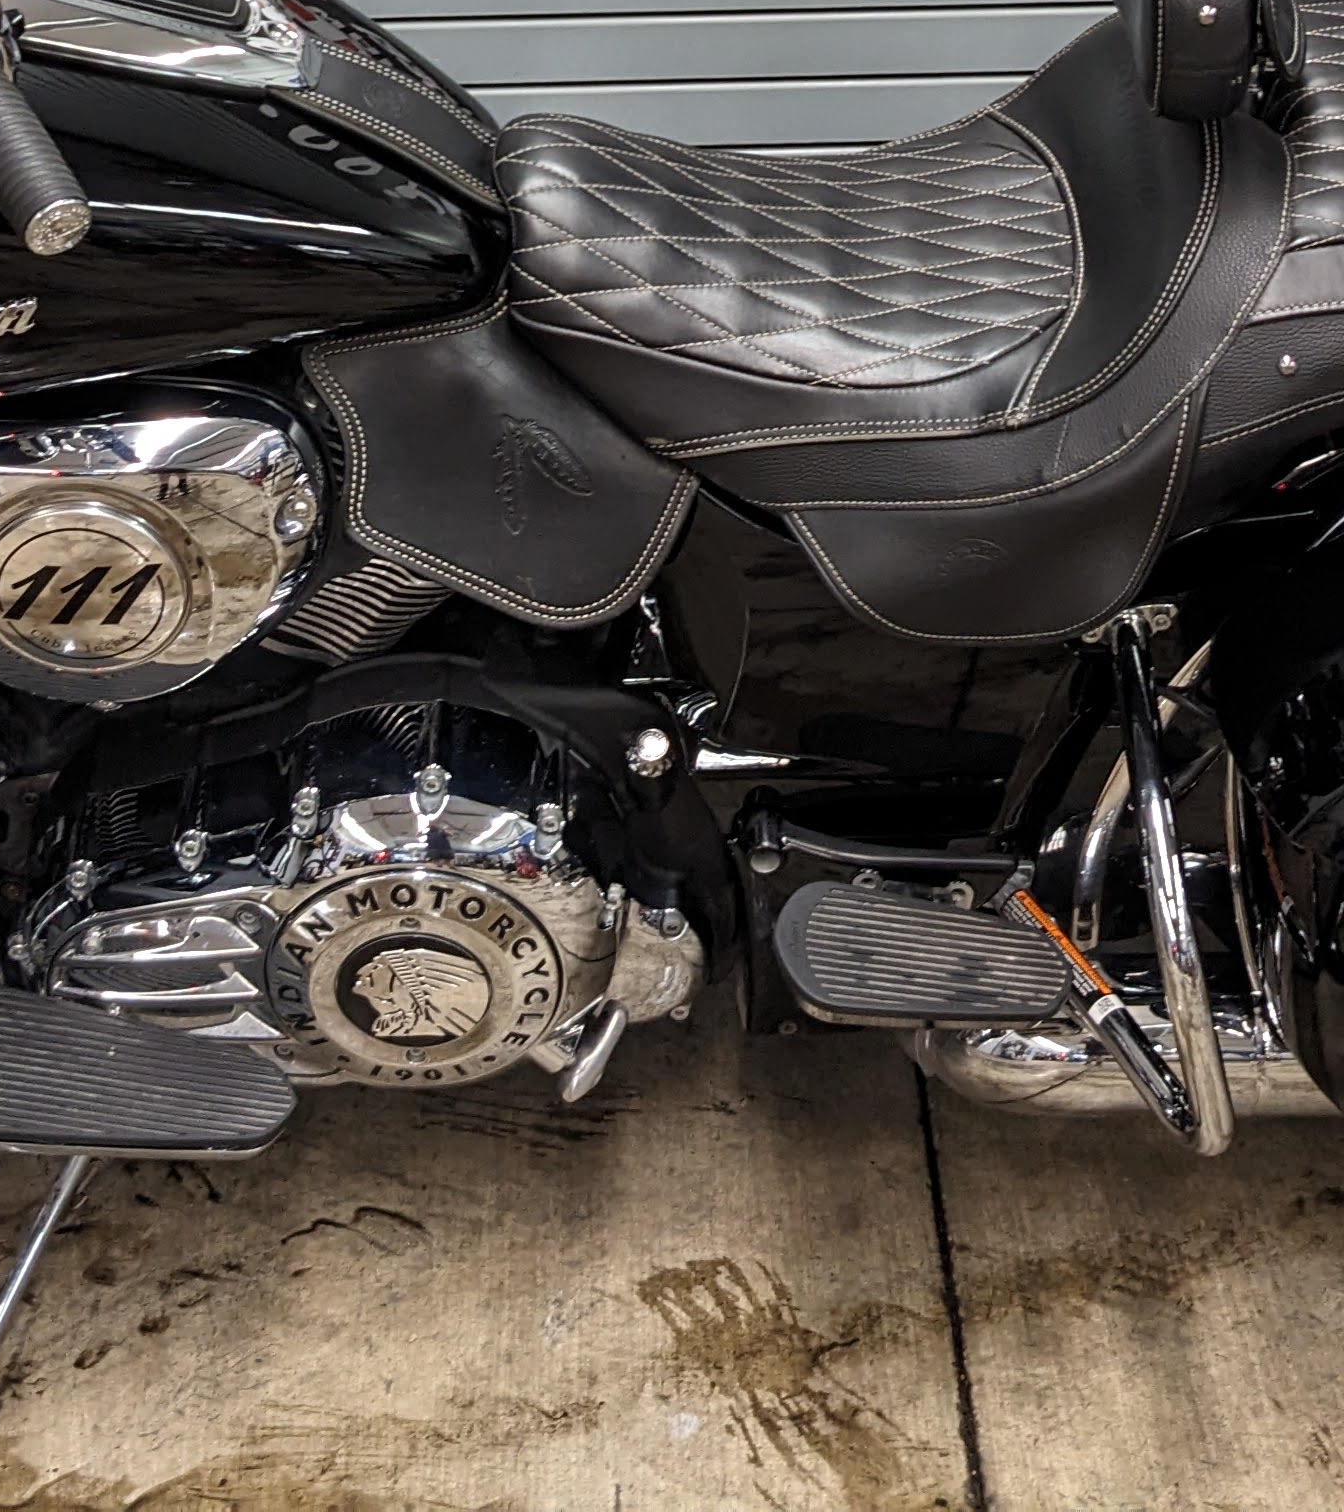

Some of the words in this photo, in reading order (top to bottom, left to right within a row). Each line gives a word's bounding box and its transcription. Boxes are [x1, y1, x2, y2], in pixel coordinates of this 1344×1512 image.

[2, 562, 164, 626] 111
[277, 908, 335, 1047] INDIAN
[345, 883, 551, 1048] MOTORCYCLE
[369, 1063, 468, 1081] 1901
